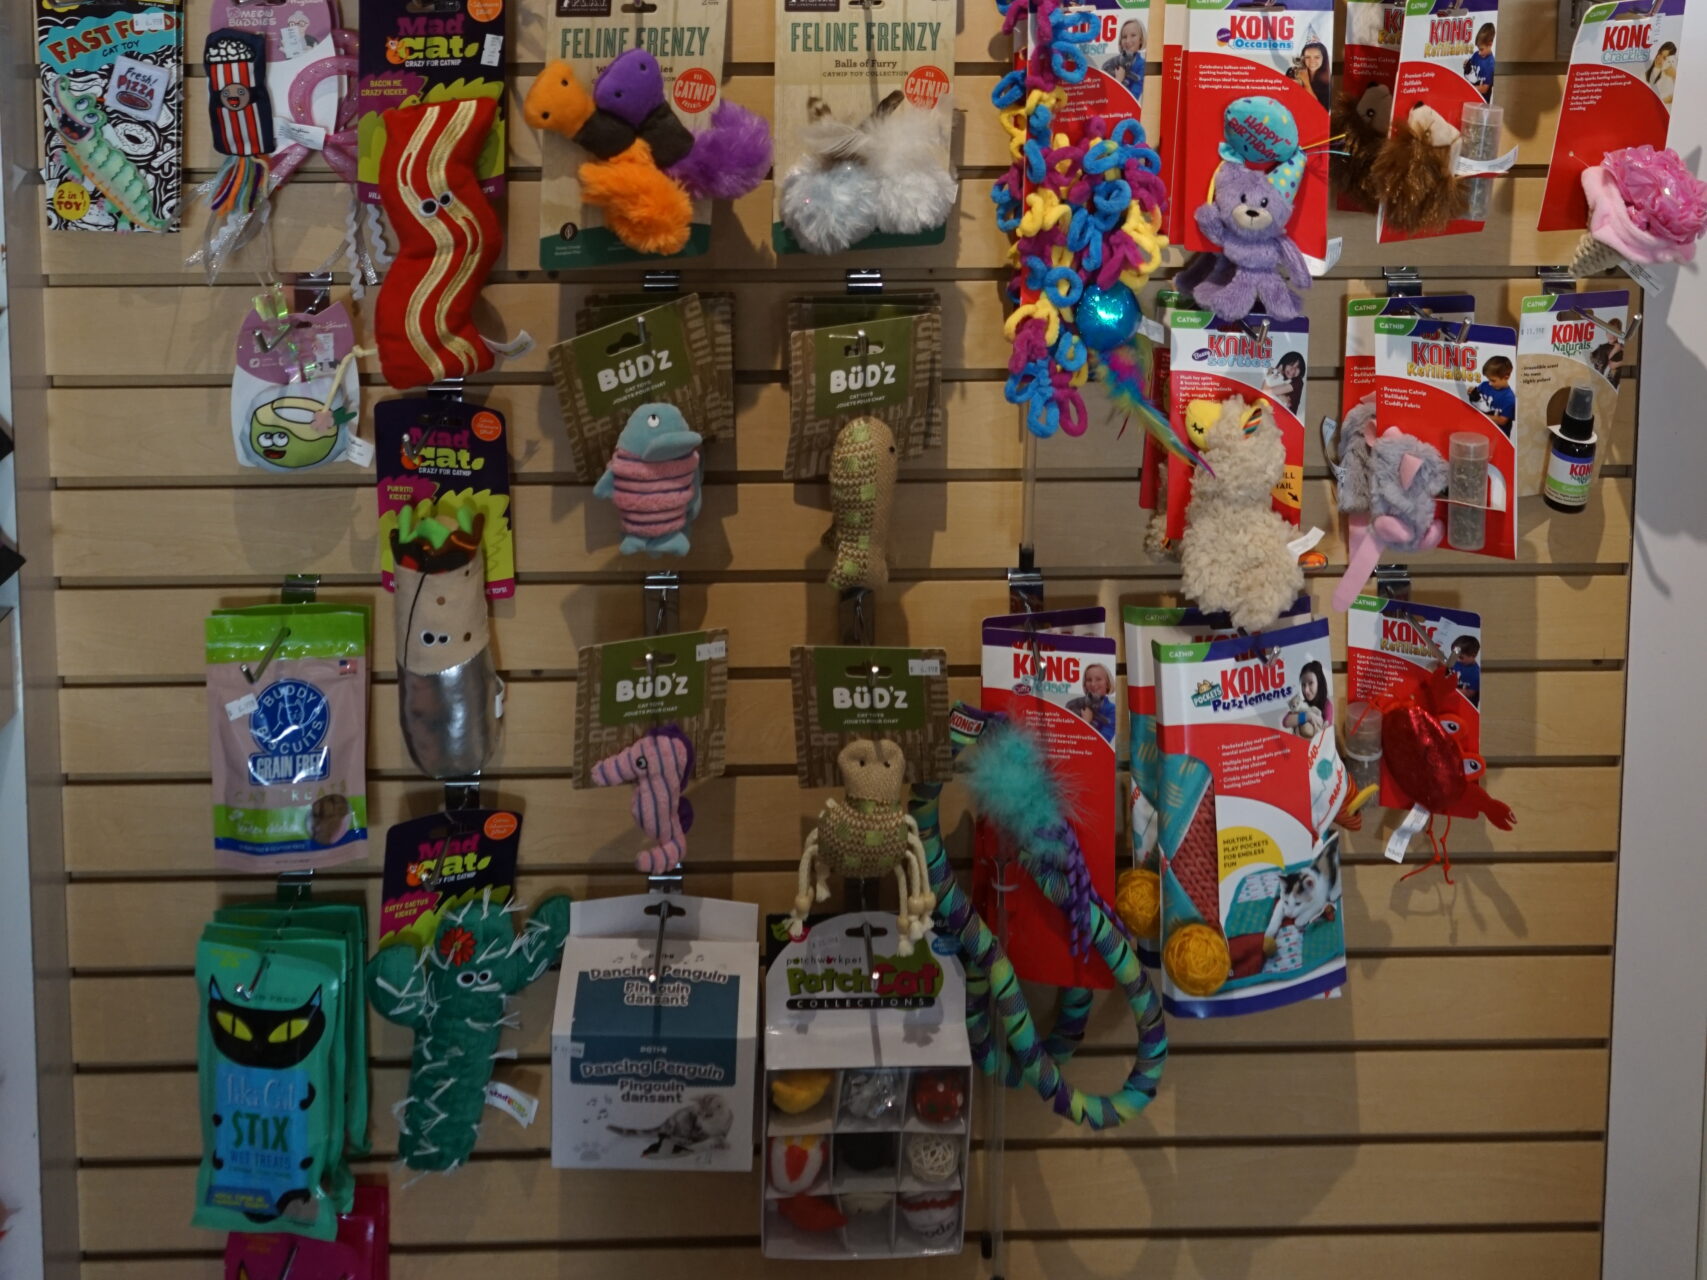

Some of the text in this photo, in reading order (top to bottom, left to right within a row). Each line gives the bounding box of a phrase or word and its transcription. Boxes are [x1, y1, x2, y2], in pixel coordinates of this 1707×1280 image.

[397, 14, 465, 34] Mad
[1231, 16, 1294, 40] KONG
[1429, 18, 1473, 44] KONG
[47, 26, 112, 64] FAST
[791, 22, 941, 52] FELINE FRENZY
[1235, 39, 1294, 49] Occasions
[871, 60, 896, 70] Furry
[674, 79, 716, 101] CATNIP
[1228, 117, 1280, 161] BIRTHDAY
[1244, 115, 1281, 145] HAPPY
[1176, 315, 1202, 324] CATNIP
[1379, 321, 1405, 330] CATNIP
[1551, 322, 1595, 343] KONG
[1412, 341, 1478, 368] KONG
[1407, 363, 1482, 384] Refillables
[1168, 648, 1194, 658] CATNIP
[1220, 658, 1285, 698] KONG
[1212, 686, 1293, 713] Puzzlements
[256, 756, 293, 777] GRAIN
[1223, 834, 1254, 846] MULTIPLE
[1241, 839, 1269, 850] POCKETS
[1237, 848, 1266, 860] ENDLESS
[662, 965, 729, 985] Penguin
[796, 997, 926, 1009] COLLECTIONS
[581, 1061, 724, 1081] Dancing Penguin
[619, 1080, 685, 1094] Pingouin
[621, 1092, 682, 1104] dansant
[231, 1112, 289, 1152] STIX
